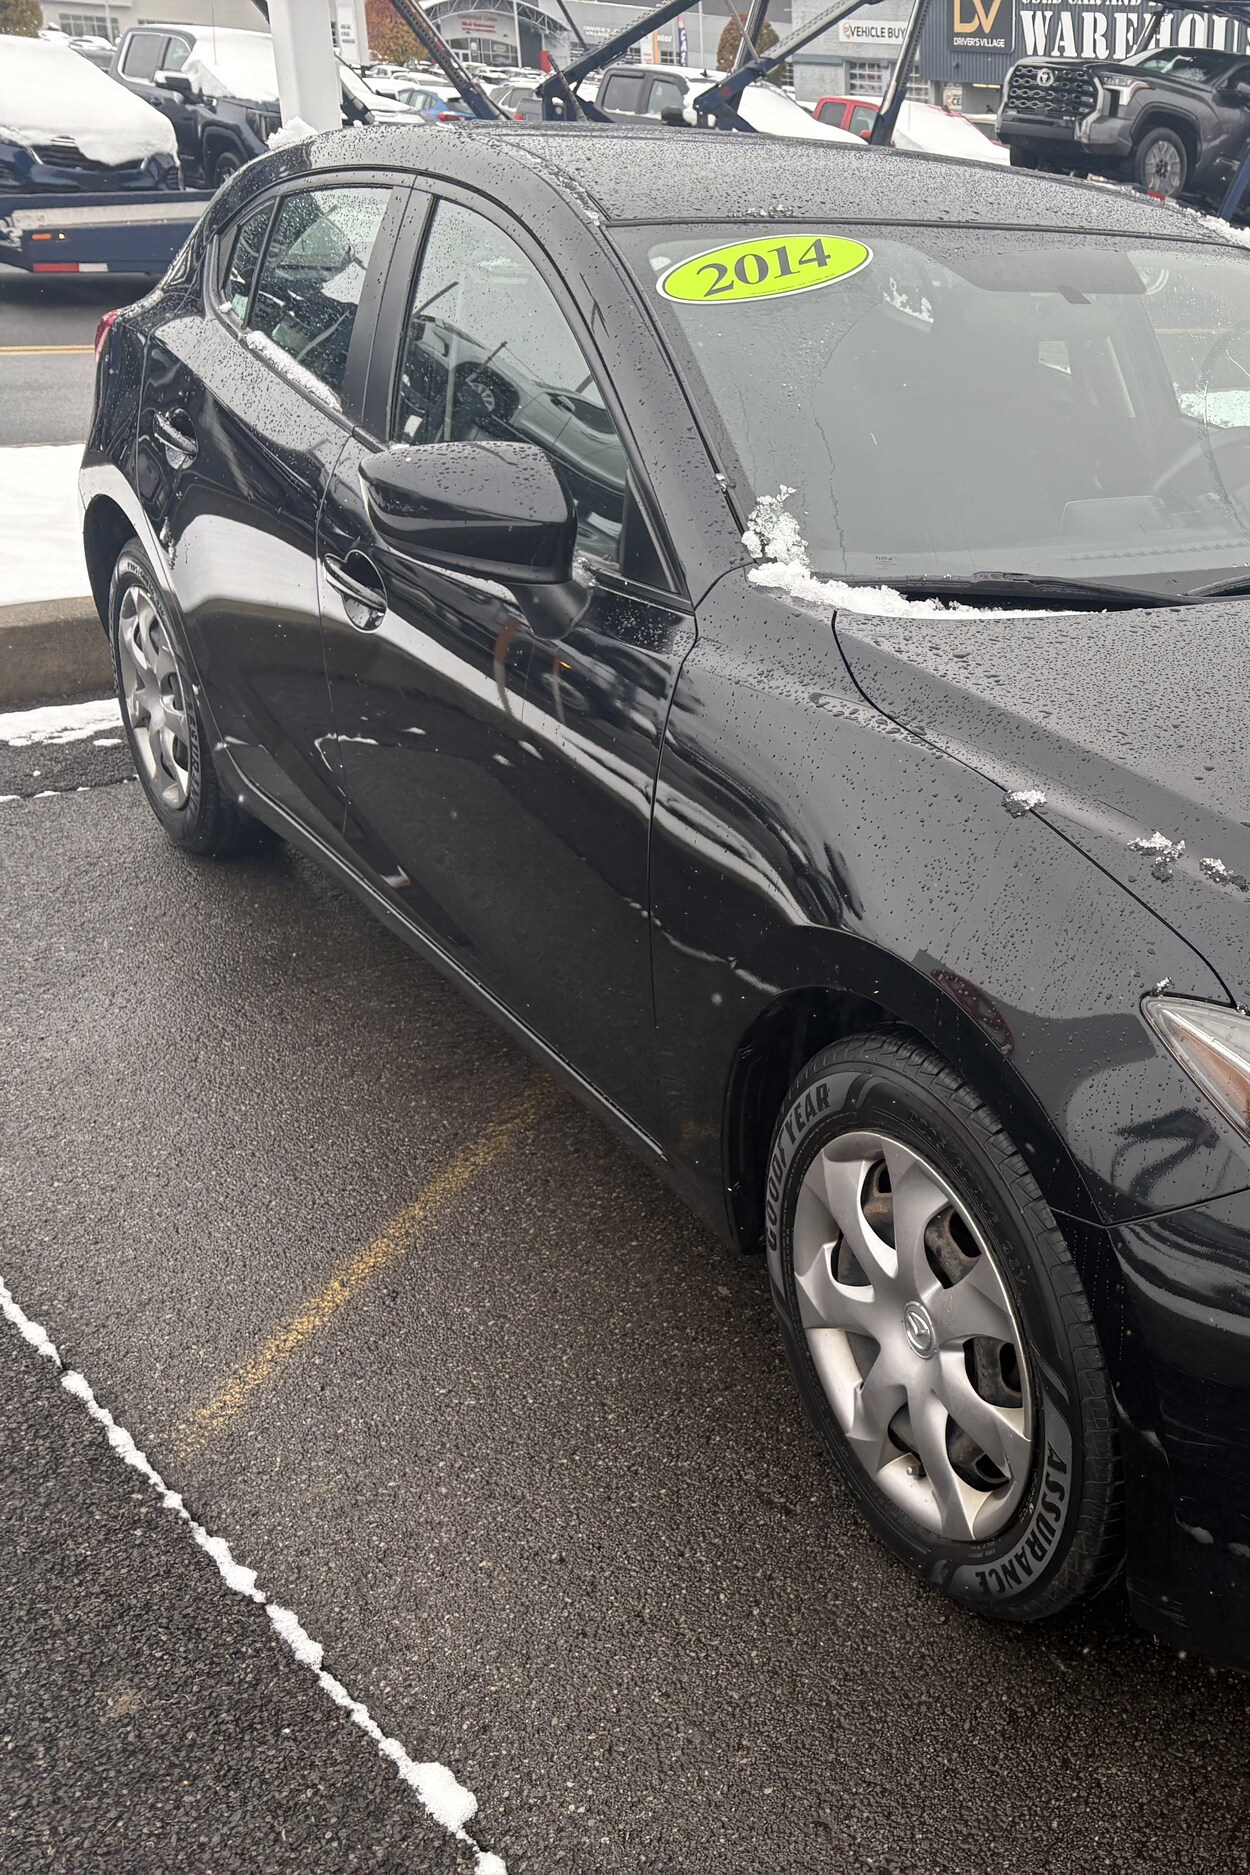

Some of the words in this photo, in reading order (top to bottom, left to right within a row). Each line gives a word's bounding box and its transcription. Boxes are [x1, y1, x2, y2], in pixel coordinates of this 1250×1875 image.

[849, 26, 886, 38] VEHICLE
[980, 38, 1006, 48] VILLAGE
[696, 238, 831, 298] 2014
[974, 1439, 1068, 1594] ASSURANCE
